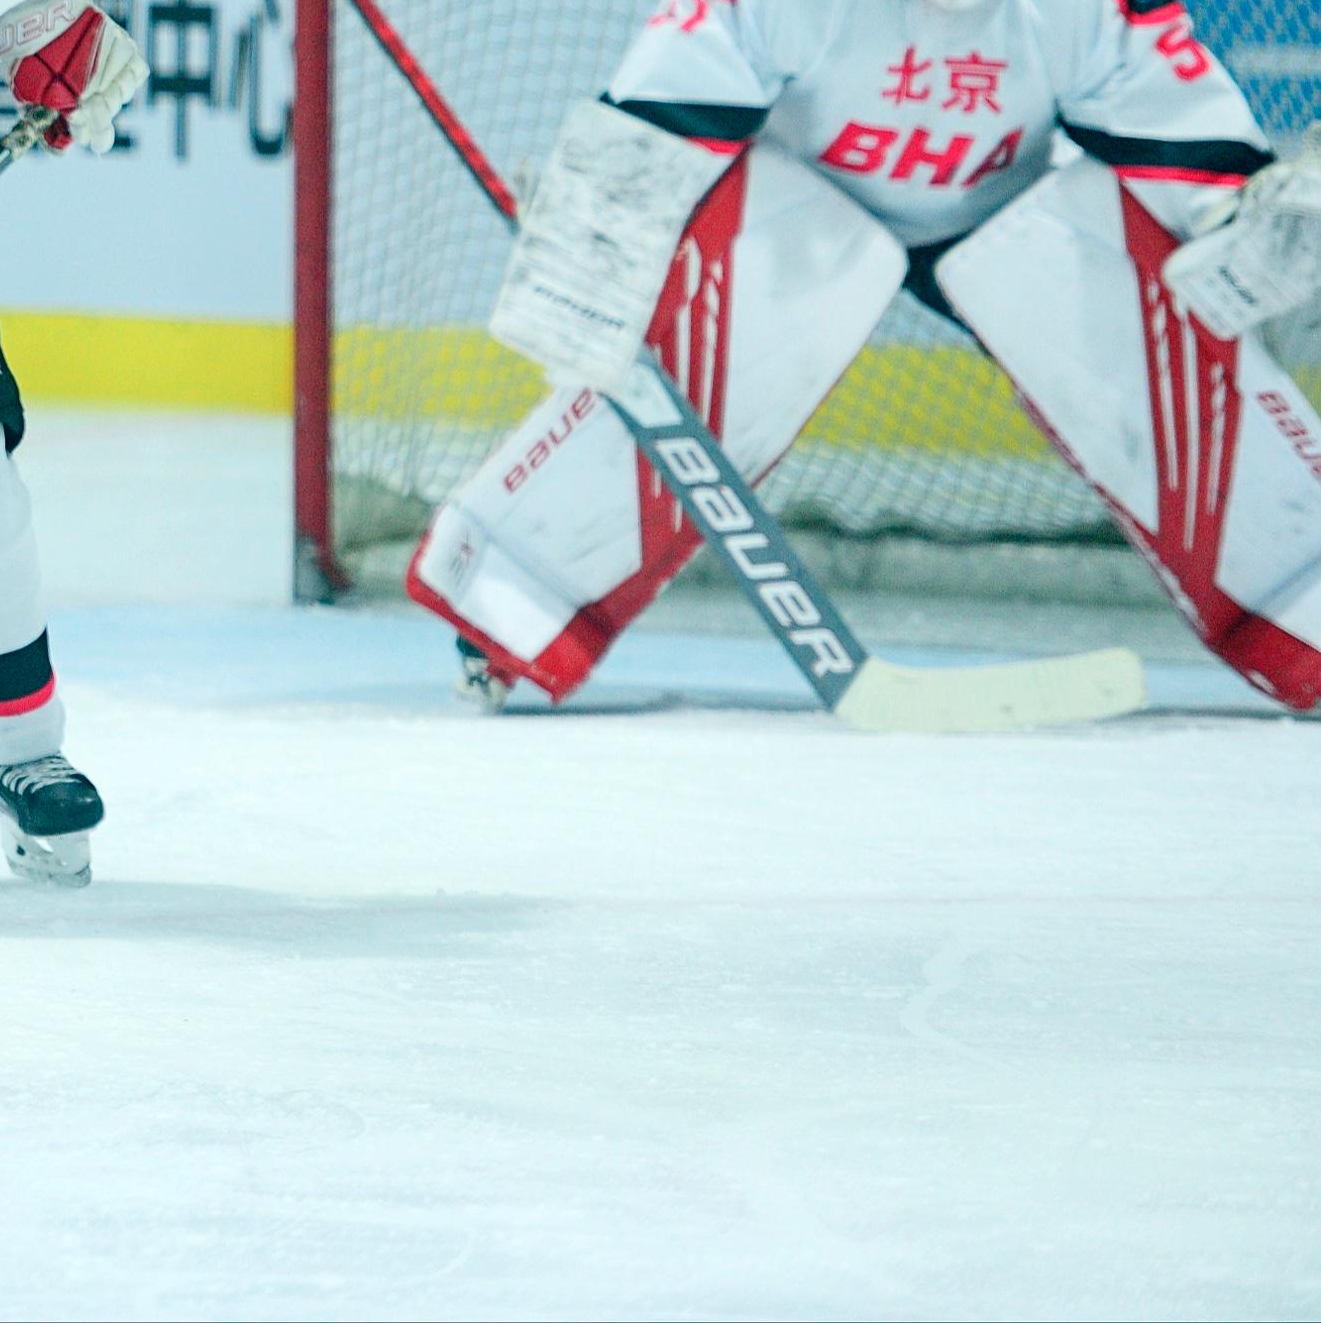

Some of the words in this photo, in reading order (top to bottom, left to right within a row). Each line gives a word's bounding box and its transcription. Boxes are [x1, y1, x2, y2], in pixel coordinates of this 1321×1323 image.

[880, 43, 1009, 114] 北京
[817, 121, 1026, 189] BHA
[654, 436, 855, 679] BAUER
